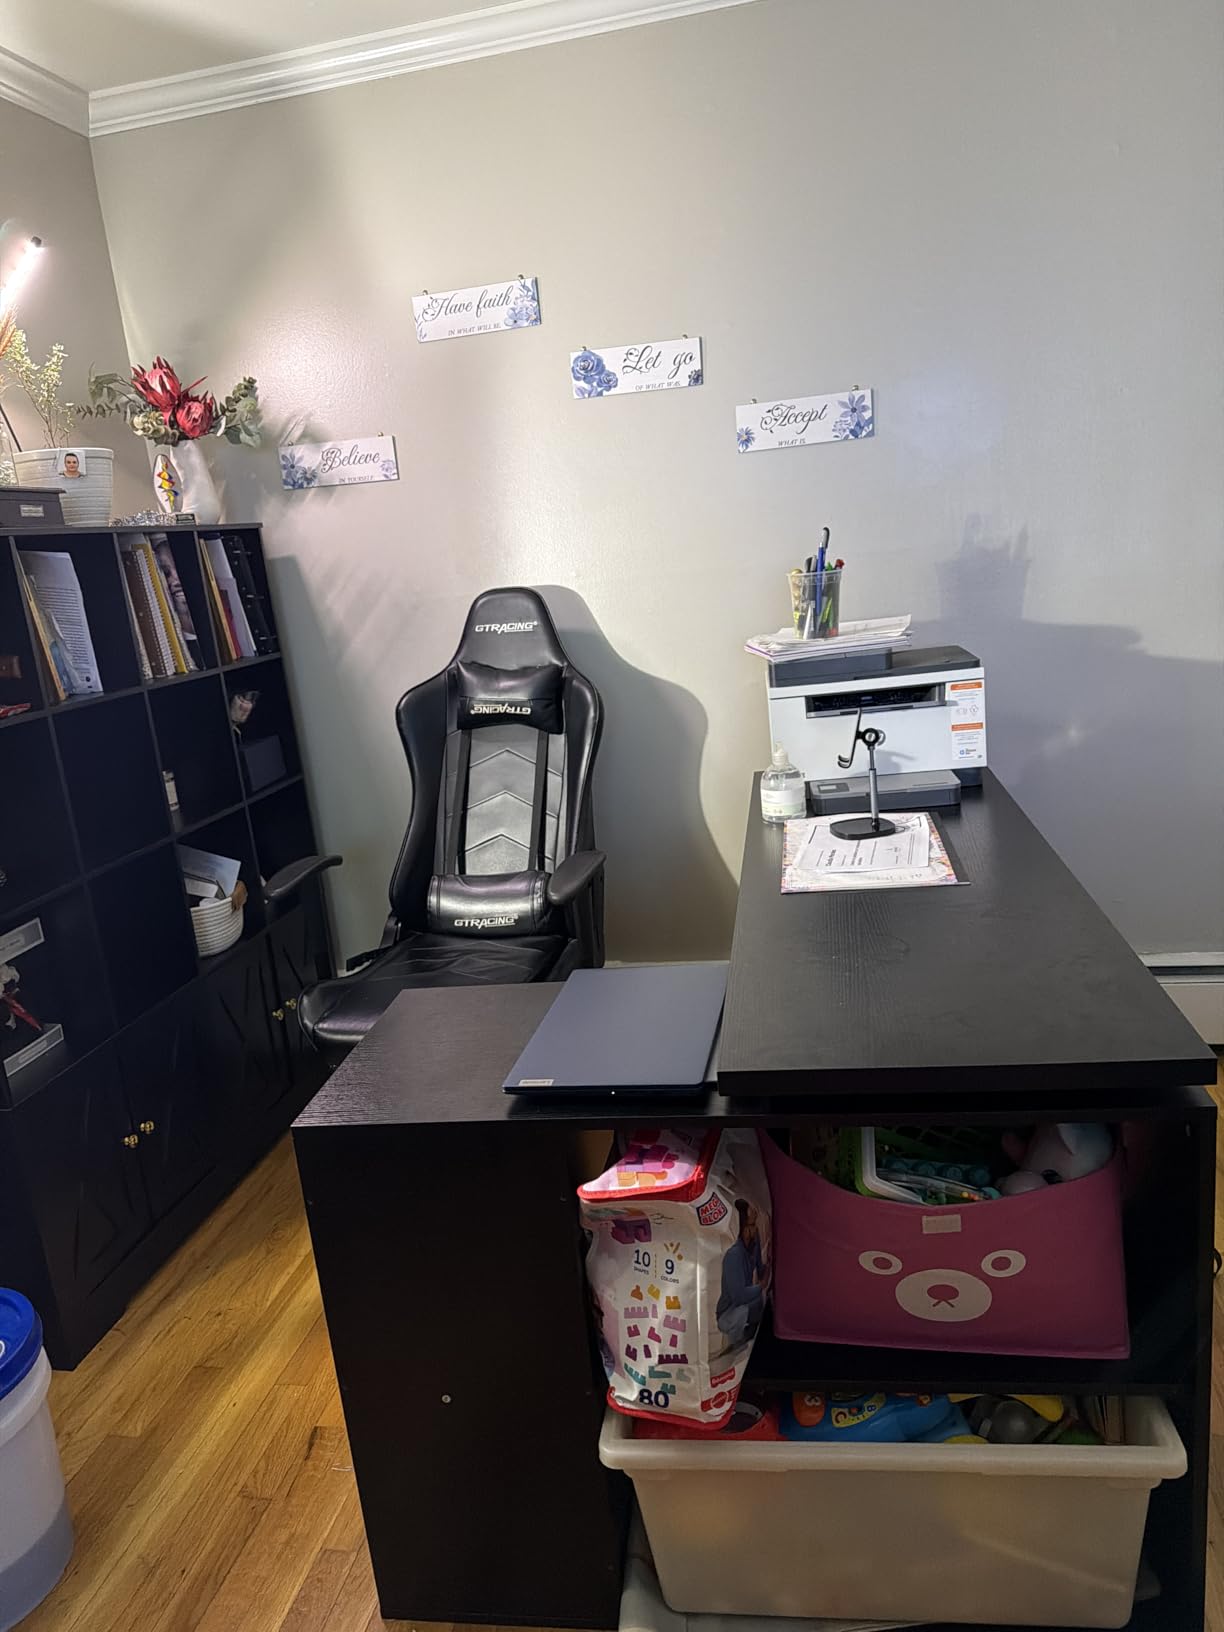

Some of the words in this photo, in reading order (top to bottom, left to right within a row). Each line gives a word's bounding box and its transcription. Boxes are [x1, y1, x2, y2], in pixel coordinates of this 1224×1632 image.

[422, 292, 474, 321] Have
[475, 285, 514, 319] faith
[457, 326, 475, 335] WHAT
[477, 324, 492, 332] WILL
[622, 345, 662, 376] Let
[667, 352, 696, 380] go
[645, 382, 665, 390] WHAT
[760, 403, 828, 435] Accept
[778, 438, 798, 447] WHAT
[321, 444, 380, 473] Believe
[634, 1249, 651, 1267] 10
[665, 1258, 675, 1275] 9
[639, 1388, 670, 1409] 80
